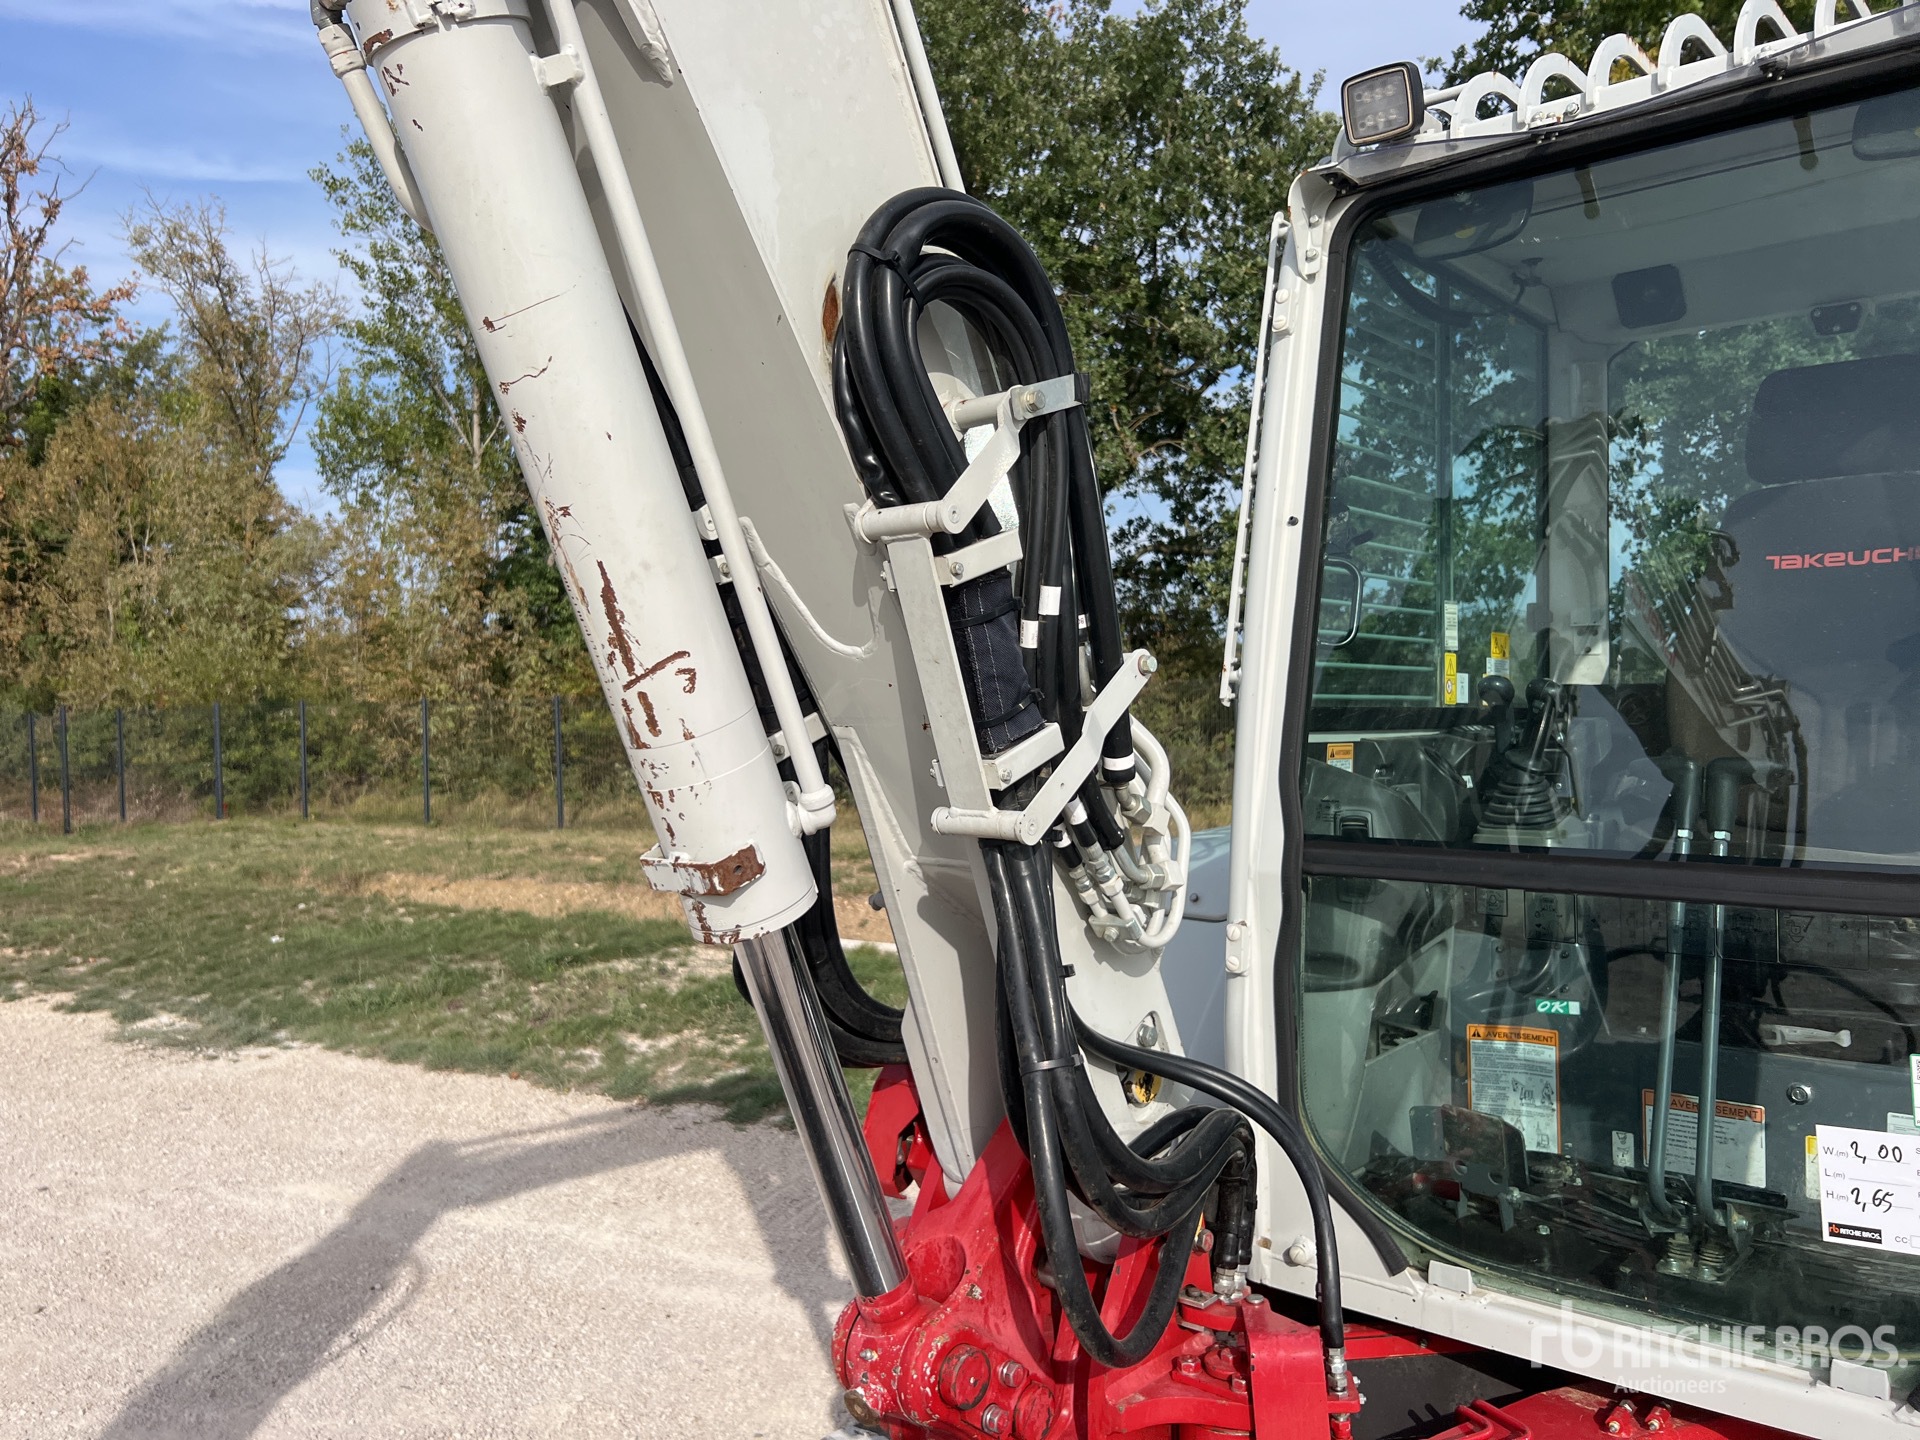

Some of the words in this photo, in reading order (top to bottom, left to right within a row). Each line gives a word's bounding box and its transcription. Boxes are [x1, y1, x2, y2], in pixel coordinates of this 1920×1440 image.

[1537, 1001, 1568, 1013] OK
[1485, 1029, 1555, 1043] AVERTISSEMENT
[1840, 1228, 1861, 1237] RITCHIE
